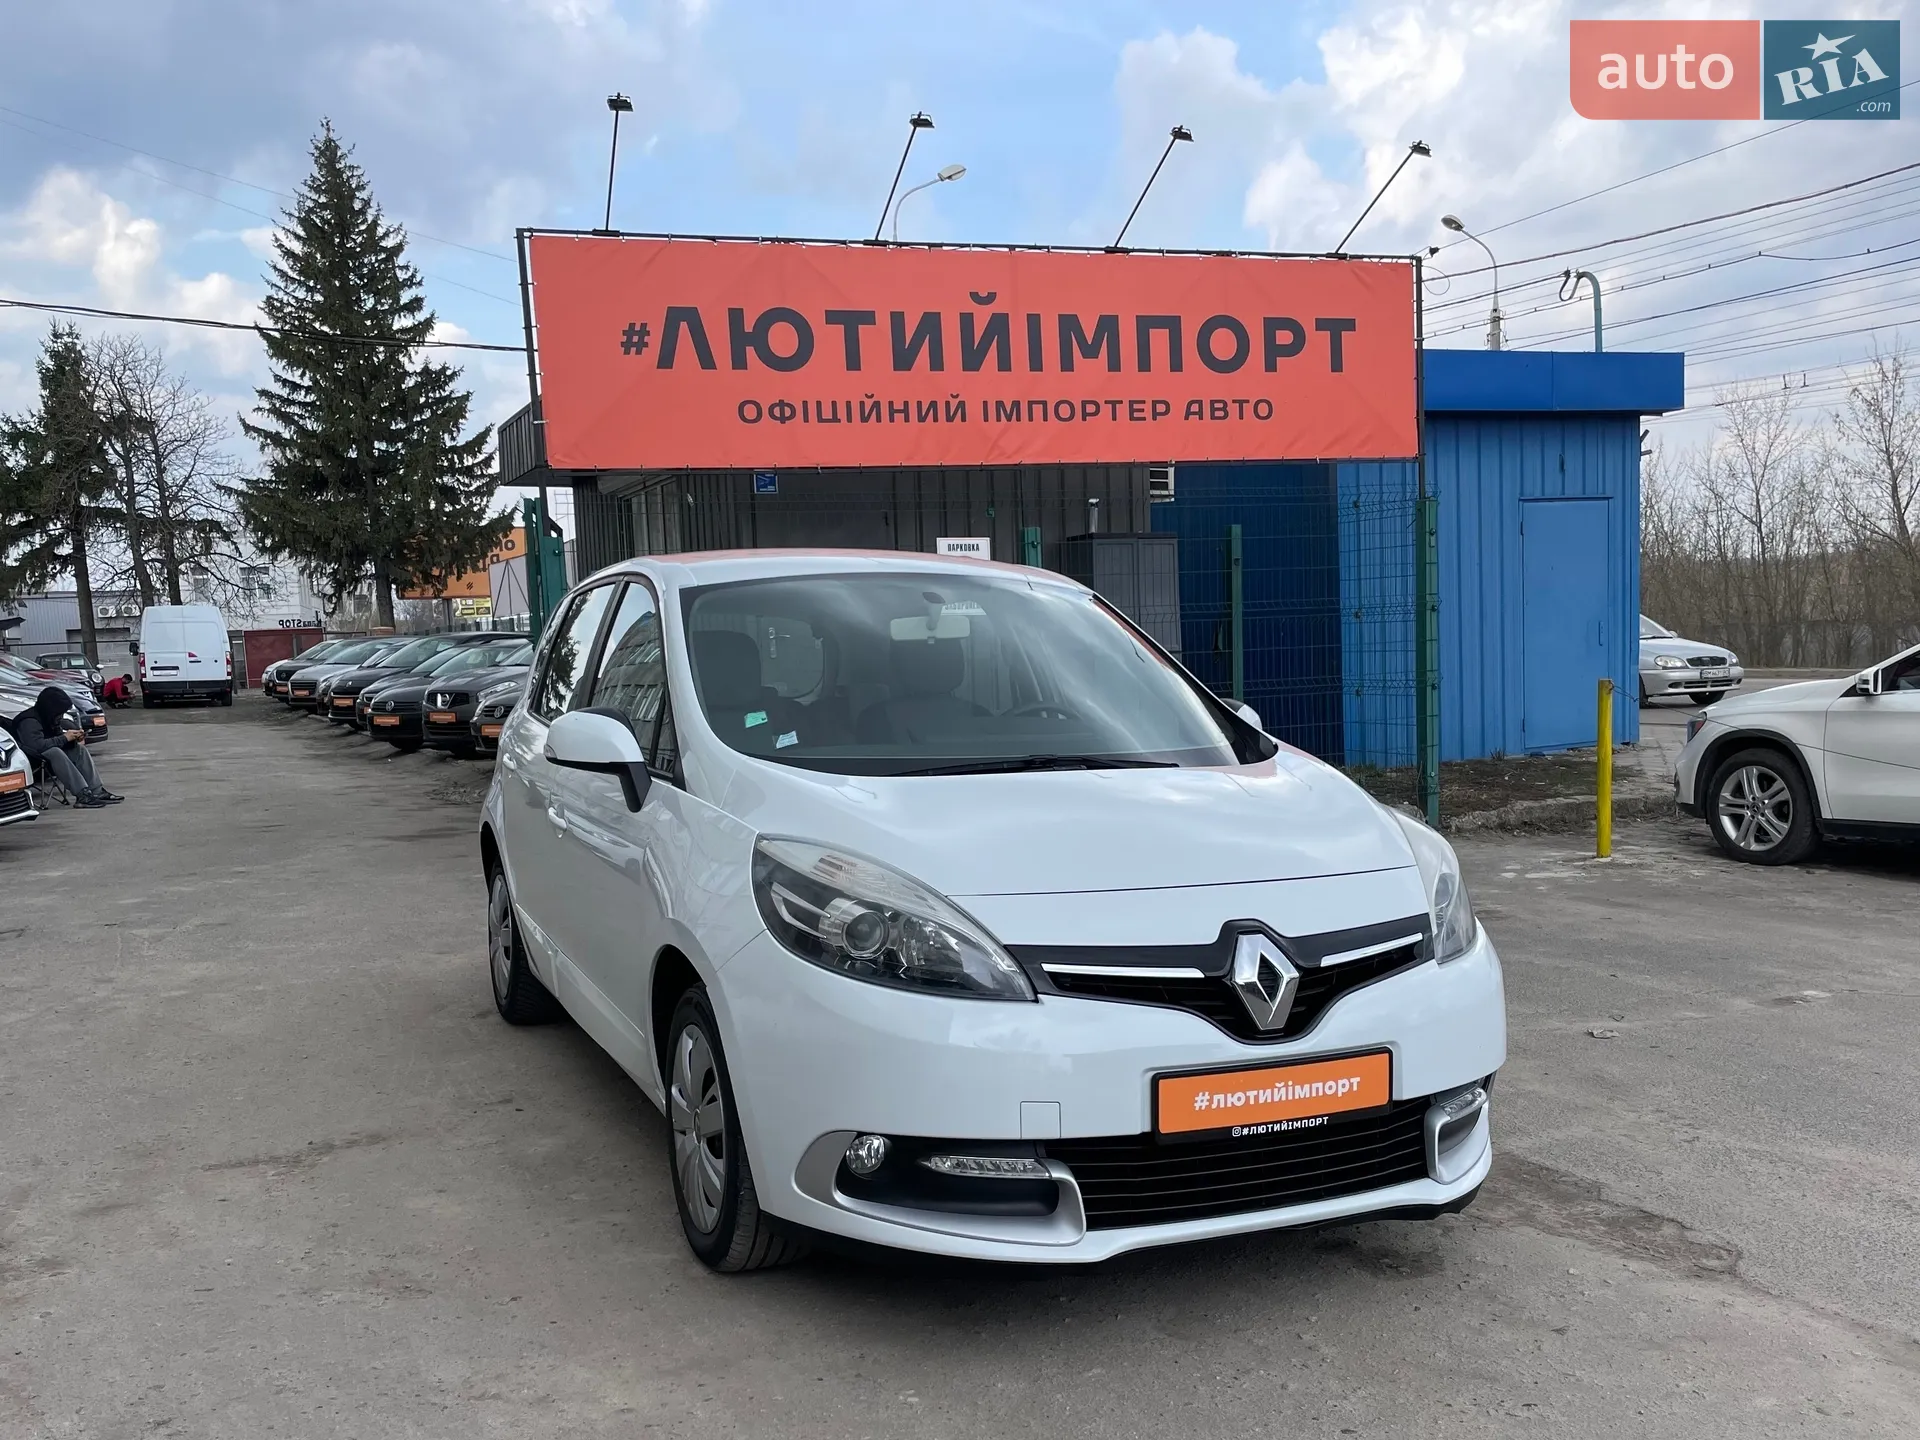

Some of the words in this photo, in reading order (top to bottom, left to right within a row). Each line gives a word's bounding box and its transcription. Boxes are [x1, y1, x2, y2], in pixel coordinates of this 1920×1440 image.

[620, 291, 1357, 374] #ЛЮТИЙІМПОРТ
[737, 394, 967, 425] ОФІЦІЙНИЙ
[982, 399, 1171, 423] ІМПОРТЕР
[1183, 398, 1274, 421] АВТО
[947, 543, 980, 552] ПАРКОВКА
[1193, 1076, 1361, 1112] #лютийімпорт
[1241, 1116, 1329, 1136] #ЛЮТИЙІМПОРТ
